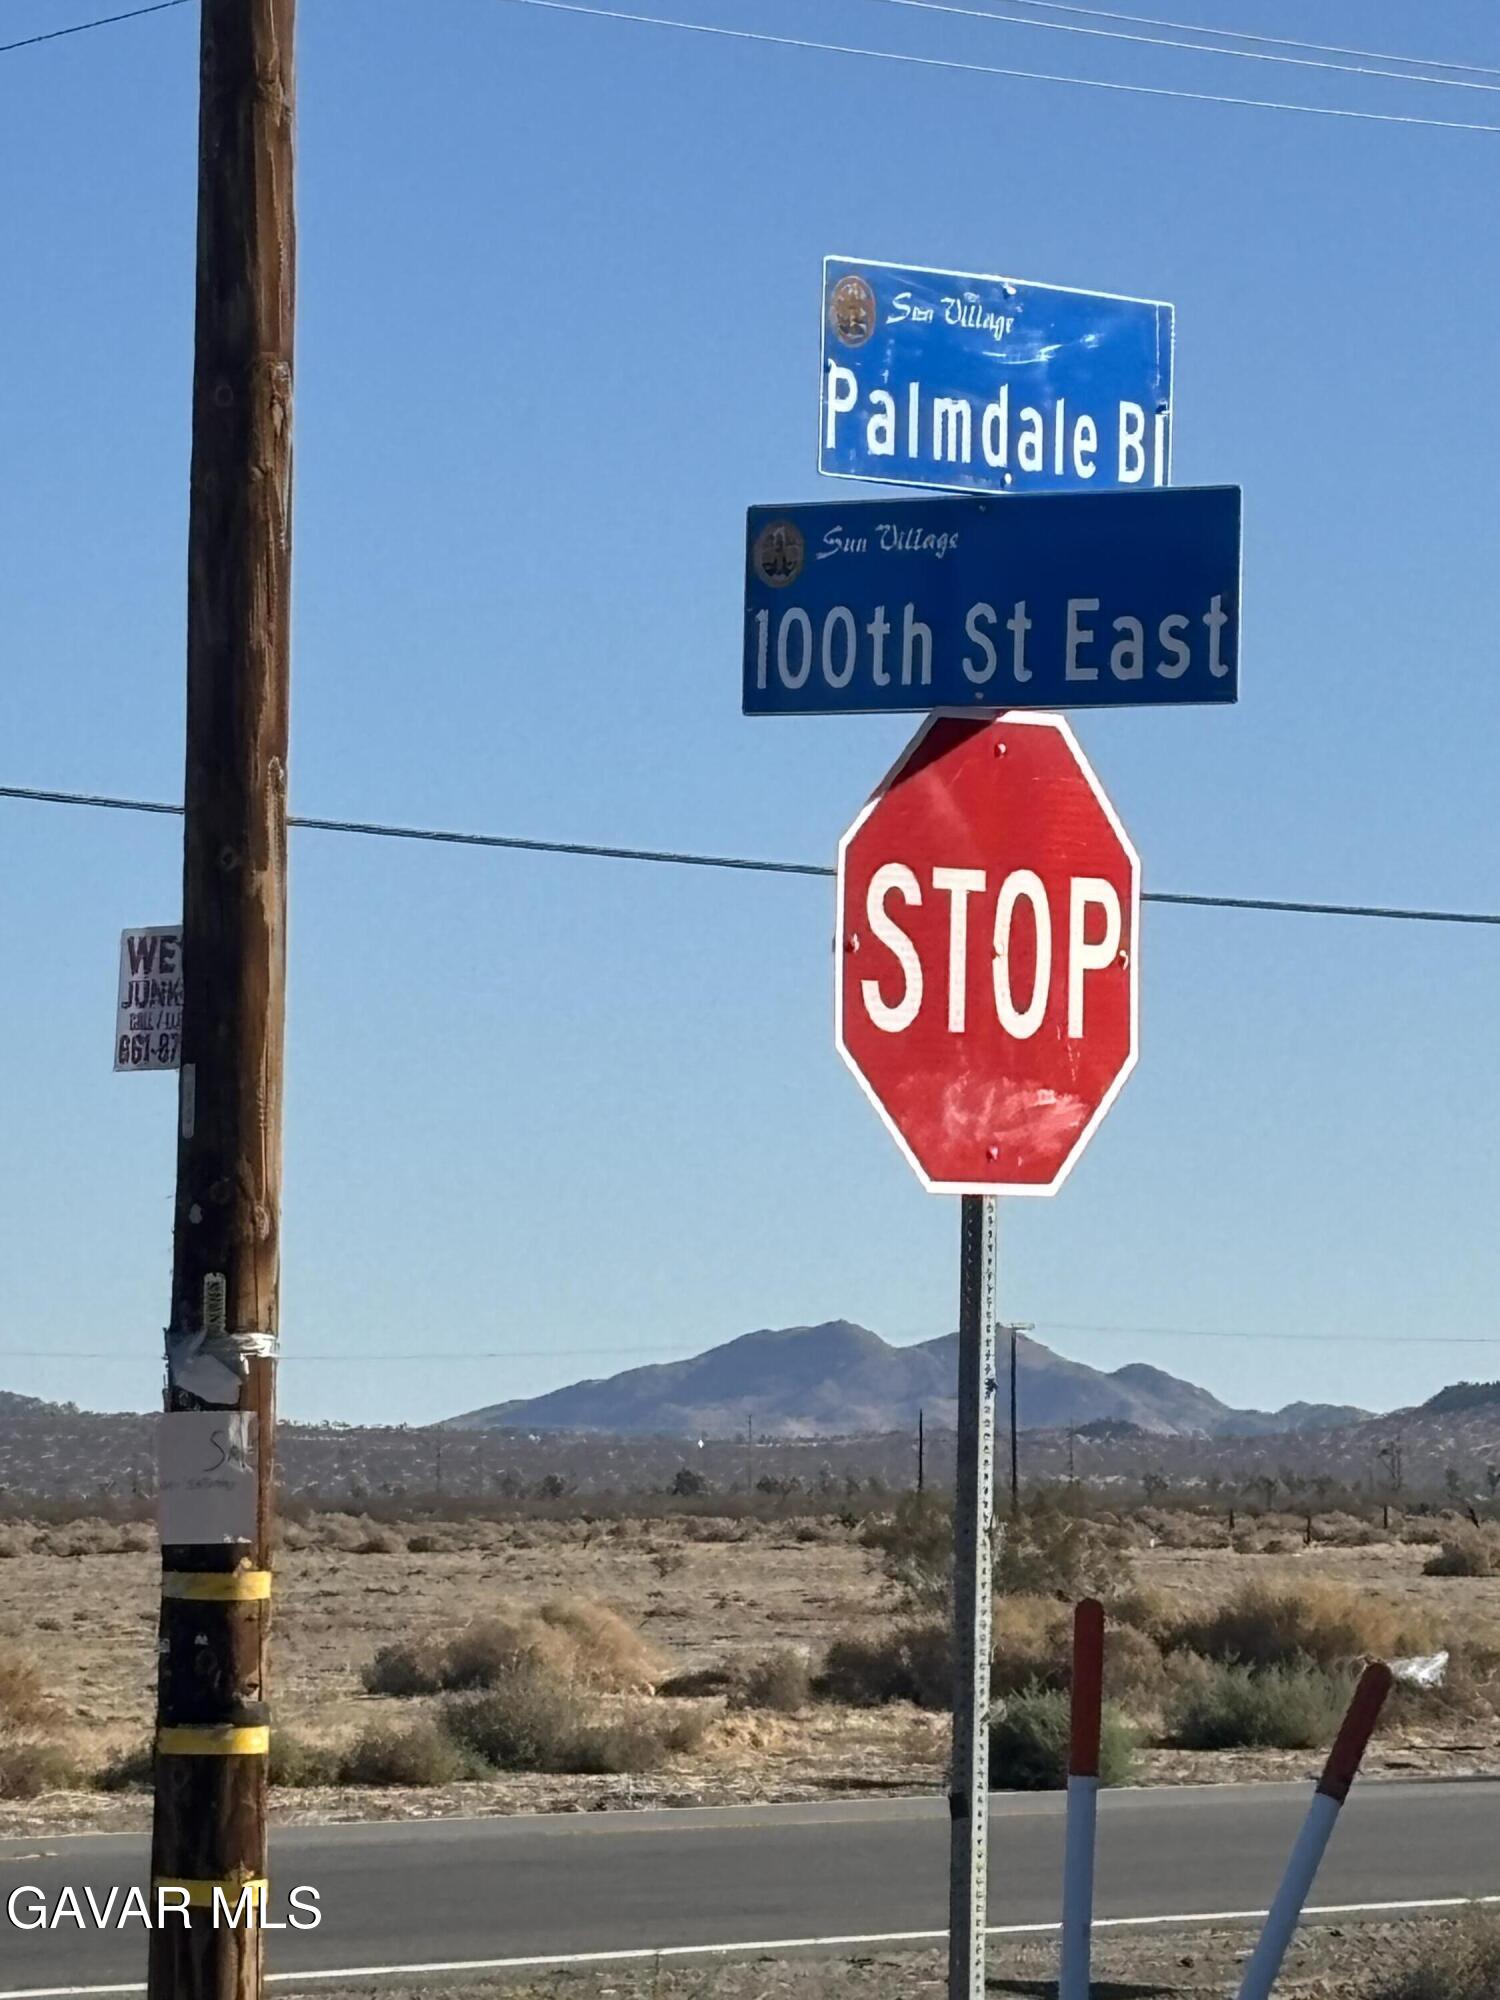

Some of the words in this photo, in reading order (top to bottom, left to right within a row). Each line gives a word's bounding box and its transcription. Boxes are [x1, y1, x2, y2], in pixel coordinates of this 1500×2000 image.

[940, 296, 1015, 341] Village
[826, 361, 1098, 479] Palmdale
[816, 526, 868, 560] Sun
[876, 523, 959, 560] Village
[755, 602, 933, 689] 100th
[962, 600, 1033, 685] St
[1064, 595, 1229, 682] East
[861, 862, 1122, 1040] STOP
